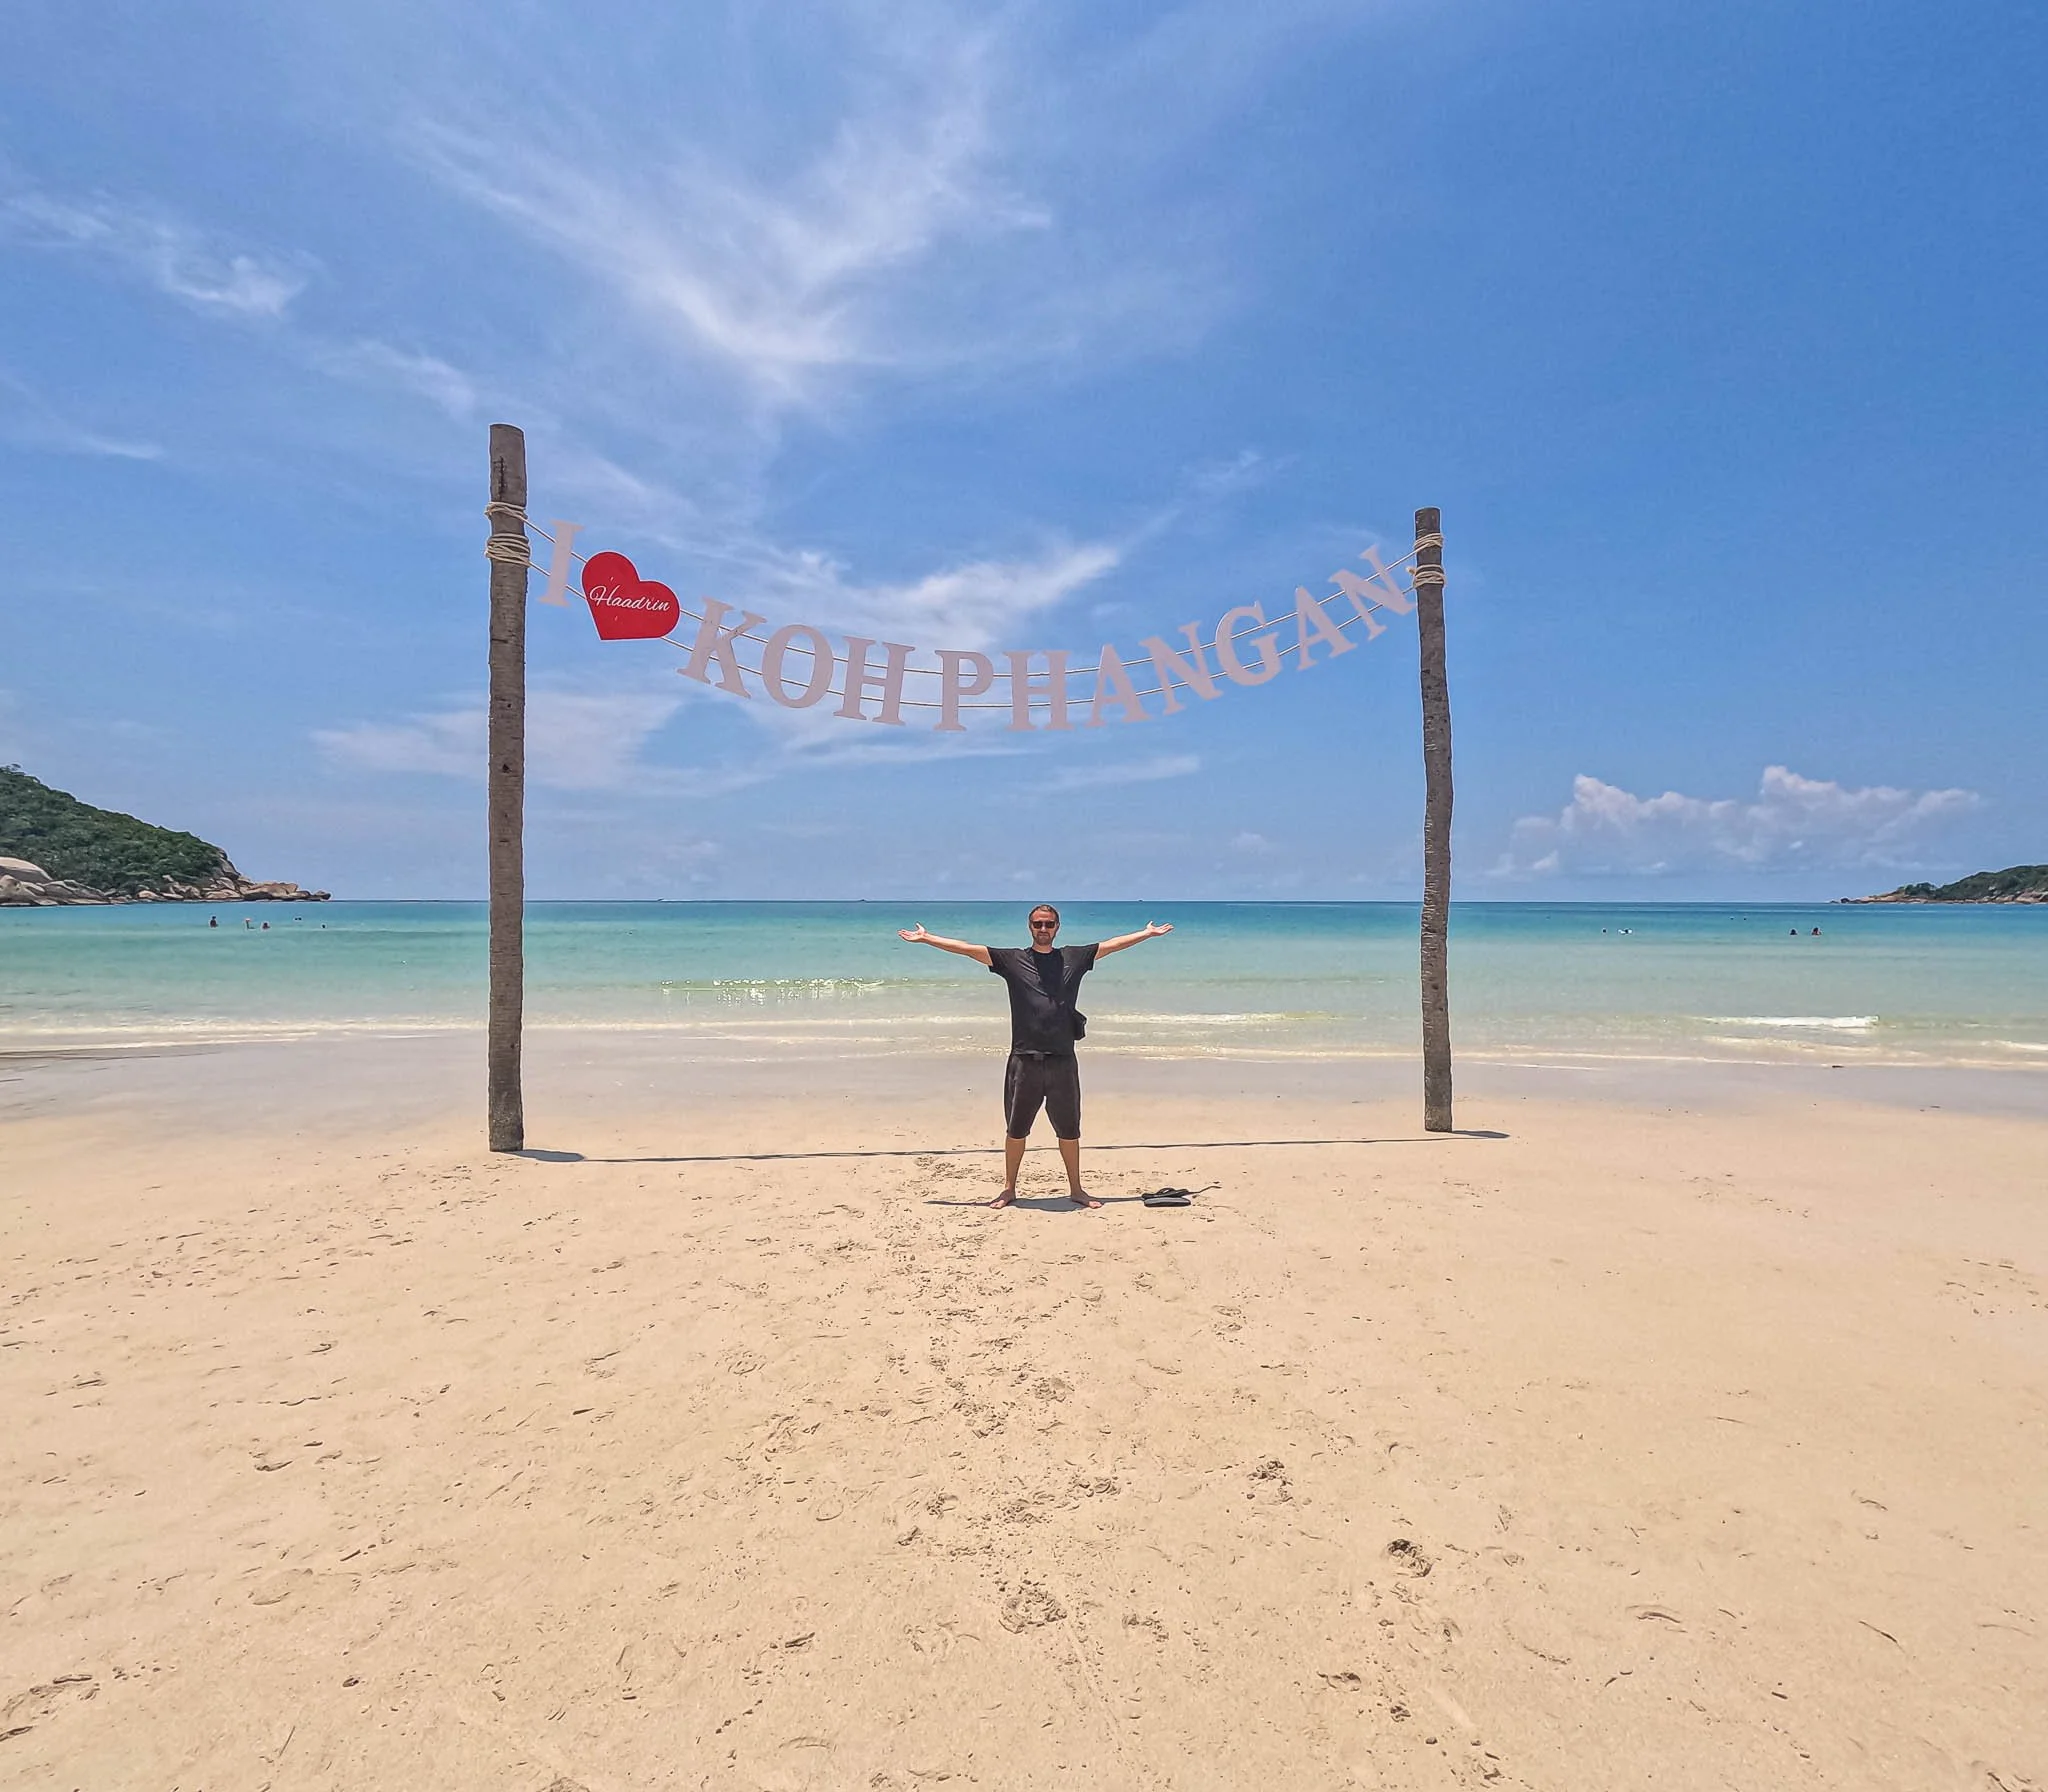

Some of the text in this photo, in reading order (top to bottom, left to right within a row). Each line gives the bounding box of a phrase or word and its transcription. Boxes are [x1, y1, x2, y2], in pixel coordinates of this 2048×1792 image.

[538, 519, 1417, 731] I KOH PHANGAN
[589, 584, 670, 612] Haadrin
